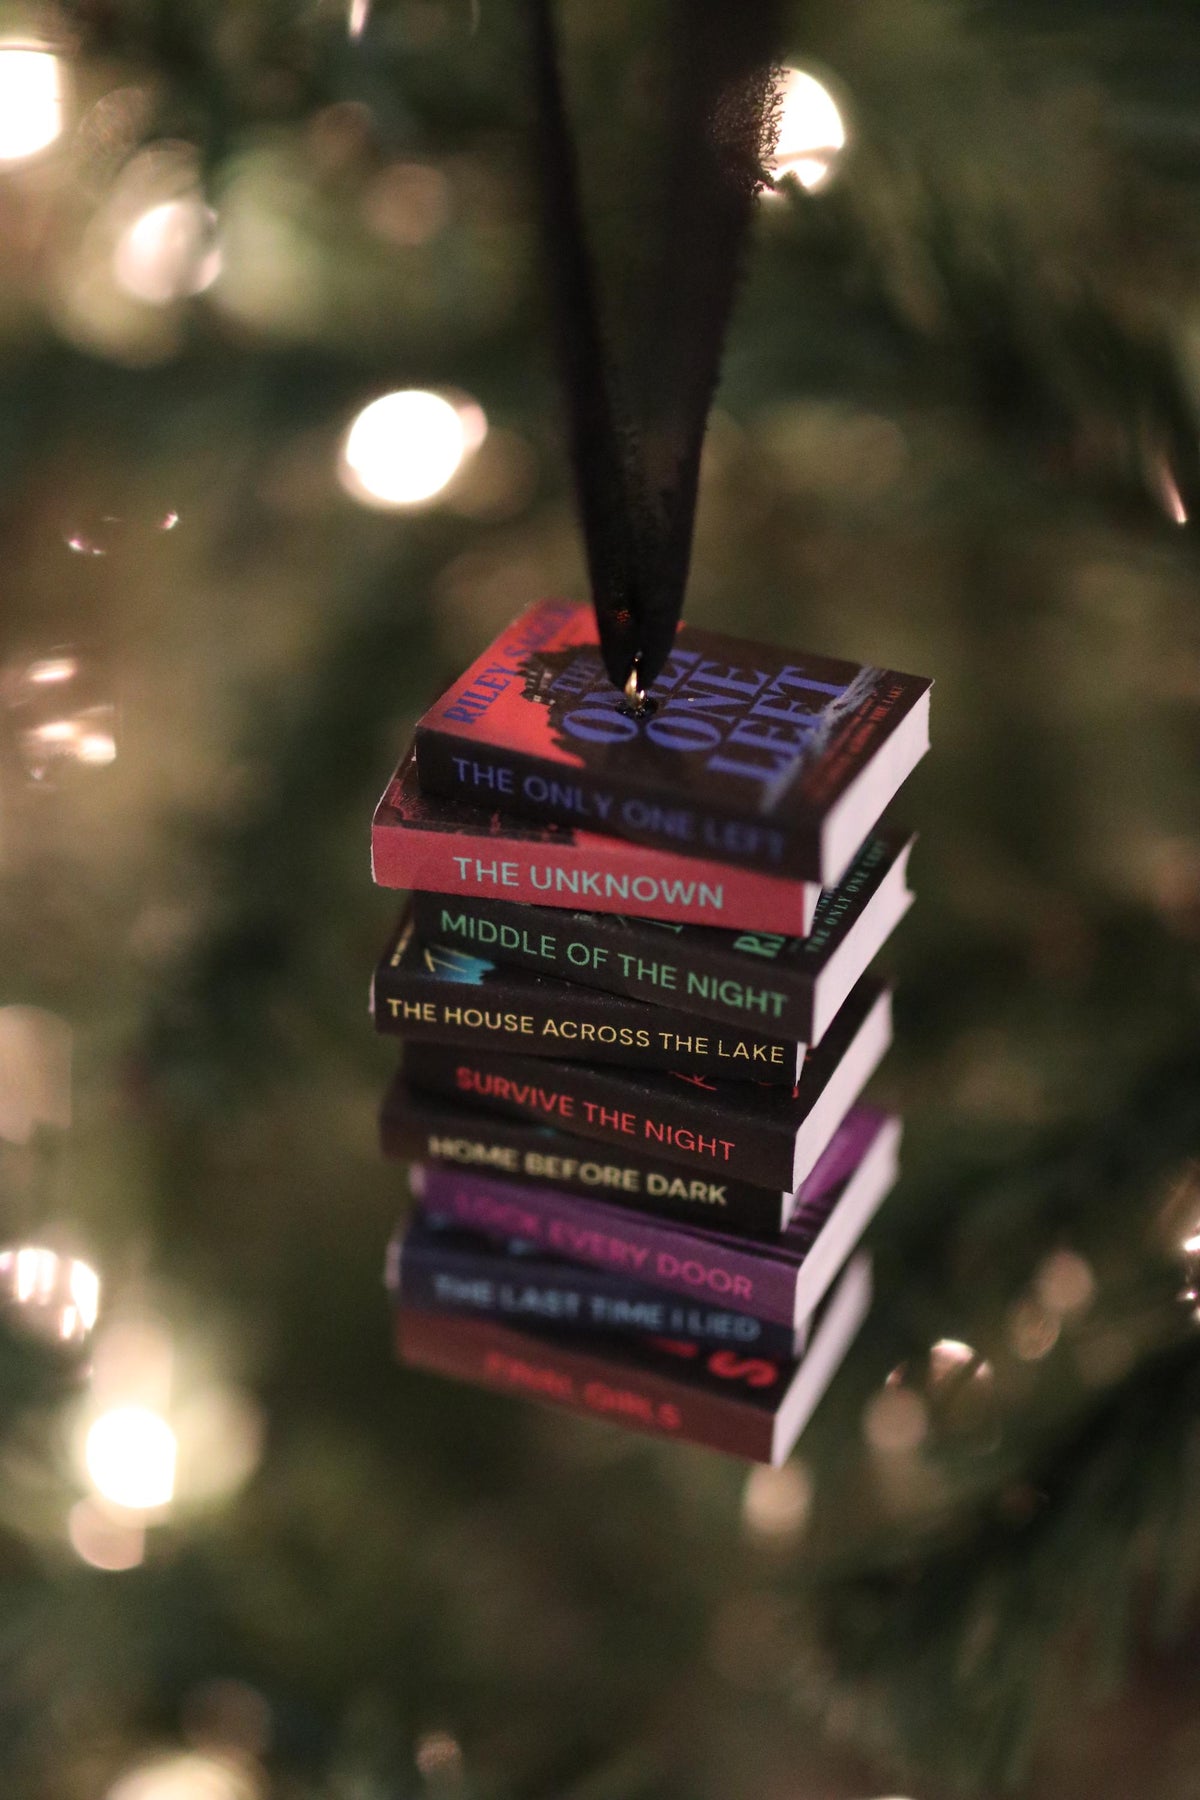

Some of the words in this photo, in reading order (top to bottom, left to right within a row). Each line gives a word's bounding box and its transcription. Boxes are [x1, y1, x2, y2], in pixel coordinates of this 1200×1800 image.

[442, 660, 519, 725] RILEY
[646, 660, 771, 750] ONE
[706, 664, 850, 784] LEFT
[452, 757, 514, 794] THE
[523, 774, 612, 819] ONLY
[622, 802, 693, 840] ONE
[706, 820, 785, 859] LEFT
[453, 857, 519, 887] THE
[531, 864, 724, 909] UNKNOWN
[441, 911, 556, 960] MIDDLE
[567, 943, 608, 969] OF
[618, 953, 676, 989] THE
[687, 972, 788, 1018] NIGHT
[387, 999, 436, 1022] THE
[445, 1007, 534, 1035] HOUSE
[542, 1018, 650, 1047] ACROSS
[659, 1032, 708, 1054] THE
[718, 1040, 785, 1064] LAKE
[455, 1067, 574, 1118] SURVIVE
[583, 1102, 636, 1134] THE
[646, 1120, 735, 1161] NIGHT
[428, 1136, 518, 1168] HOME
[525, 1152, 639, 1189] BEFORE
[647, 1173, 727, 1206] DARK
[549, 1220, 649, 1267] EVERY
[656, 1253, 753, 1300] DOOR
[434, 1274, 492, 1304] THE
[503, 1283, 581, 1318] LAST
[589, 1296, 664, 1329] TIME
[688, 1308, 763, 1343] LIED
